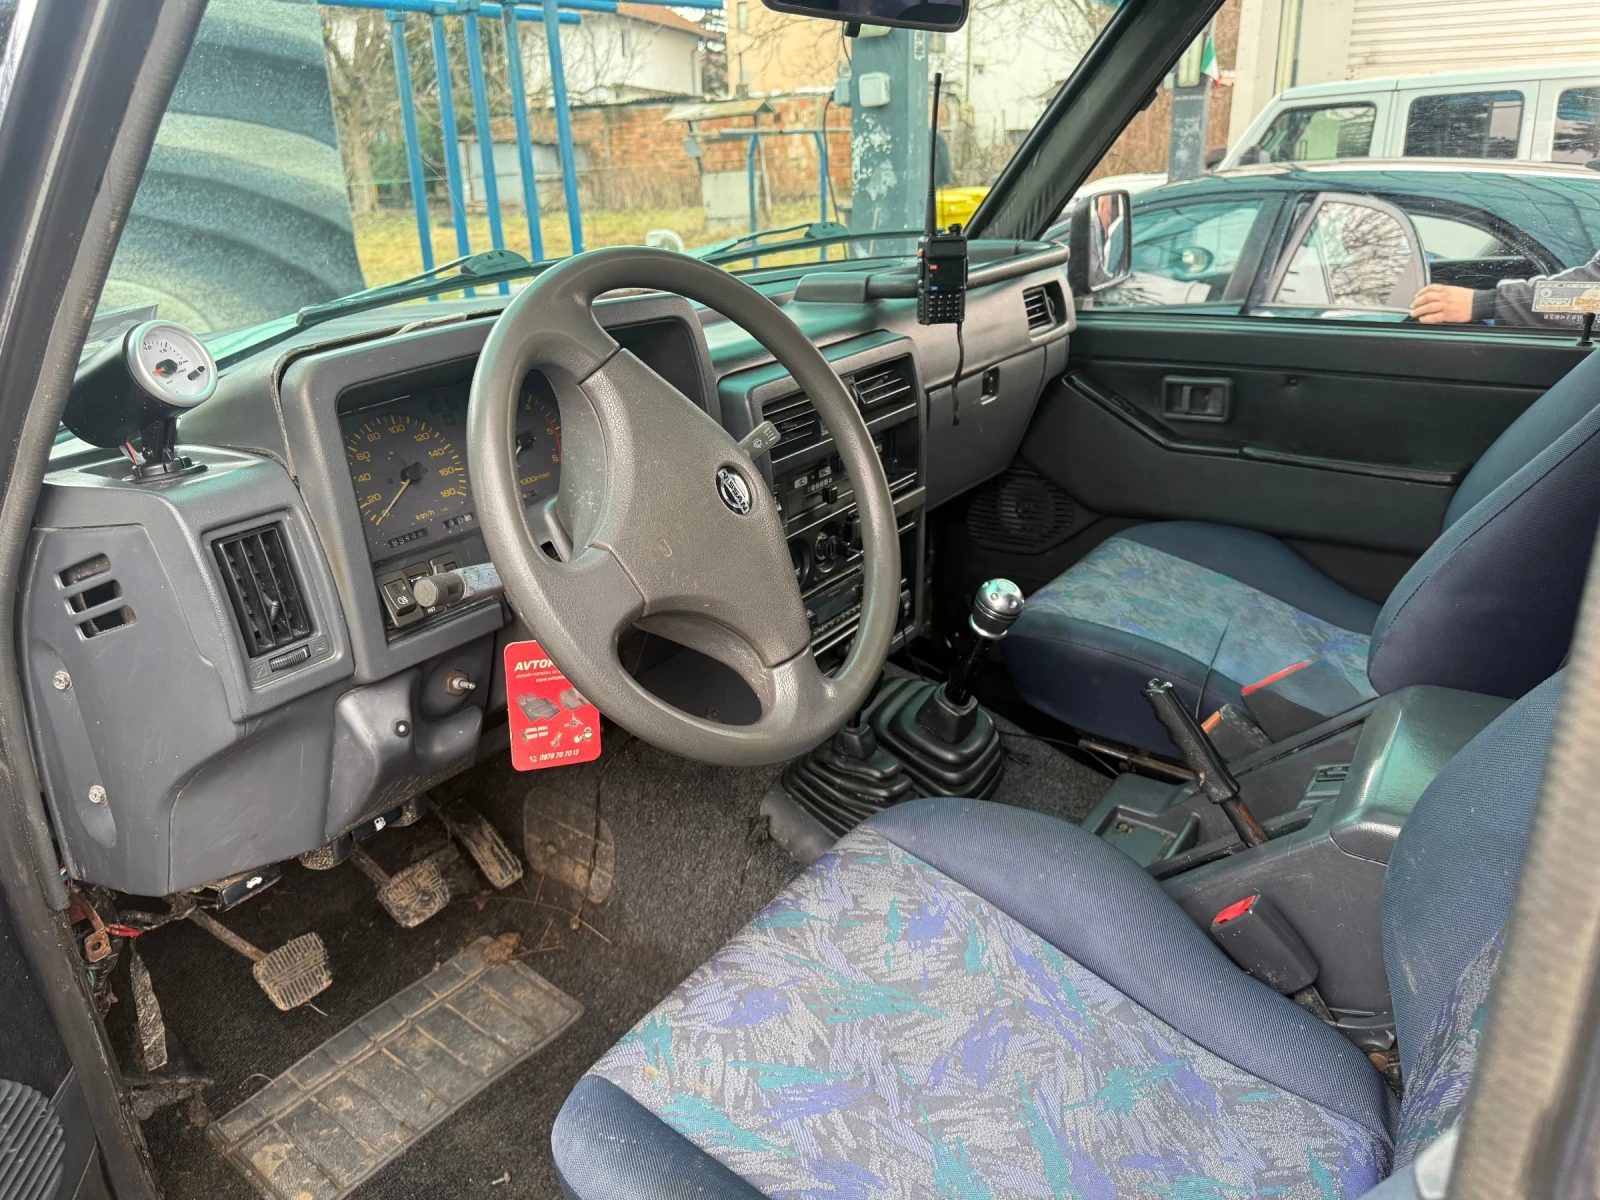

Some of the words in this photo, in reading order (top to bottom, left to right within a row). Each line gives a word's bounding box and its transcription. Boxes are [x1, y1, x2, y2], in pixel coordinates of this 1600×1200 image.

[388, 424, 405, 434] 100
[367, 432, 381, 442] 80
[413, 432, 430, 442] 120
[355, 451, 371, 461] 60
[428, 448, 445, 458] 140
[551, 454, 559, 462] 6
[438, 466, 455, 476] 160
[358, 473, 372, 482] 40
[440, 488, 456, 498] 180
[718, 469, 750, 514] NISSAN
[367, 493, 382, 504] 20
[415, 509, 435, 520] km/h
